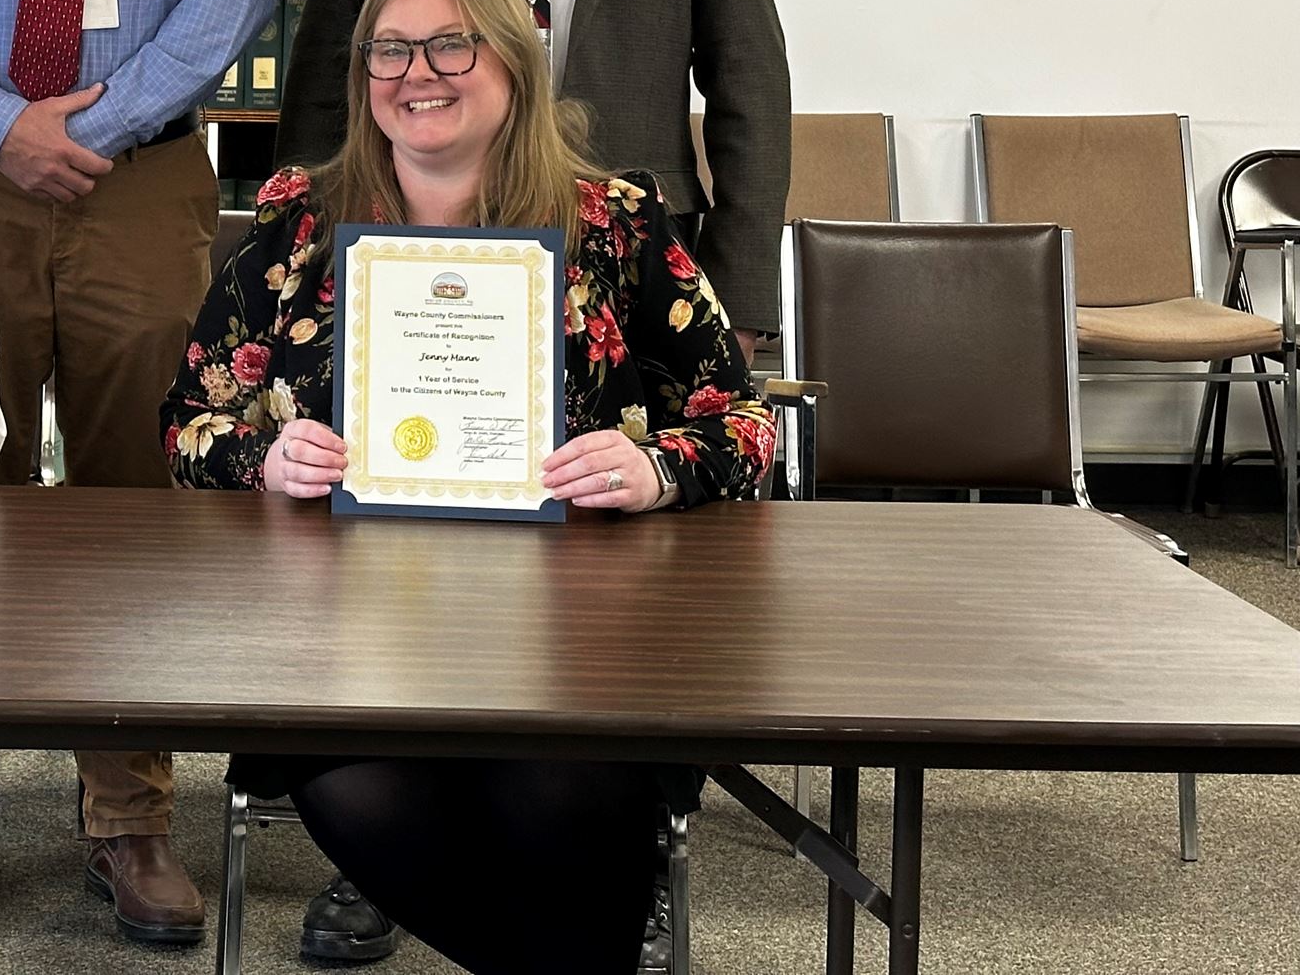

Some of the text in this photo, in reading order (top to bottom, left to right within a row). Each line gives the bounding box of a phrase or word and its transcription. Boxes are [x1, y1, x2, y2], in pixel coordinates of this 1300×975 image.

[420, 311, 446, 319] County
[403, 331, 440, 339] Certificate
[451, 333, 495, 341] Recognition
[419, 353, 480, 363] Jenny Mann
[453, 389, 477, 397] Wayne
[480, 390, 506, 398] County
